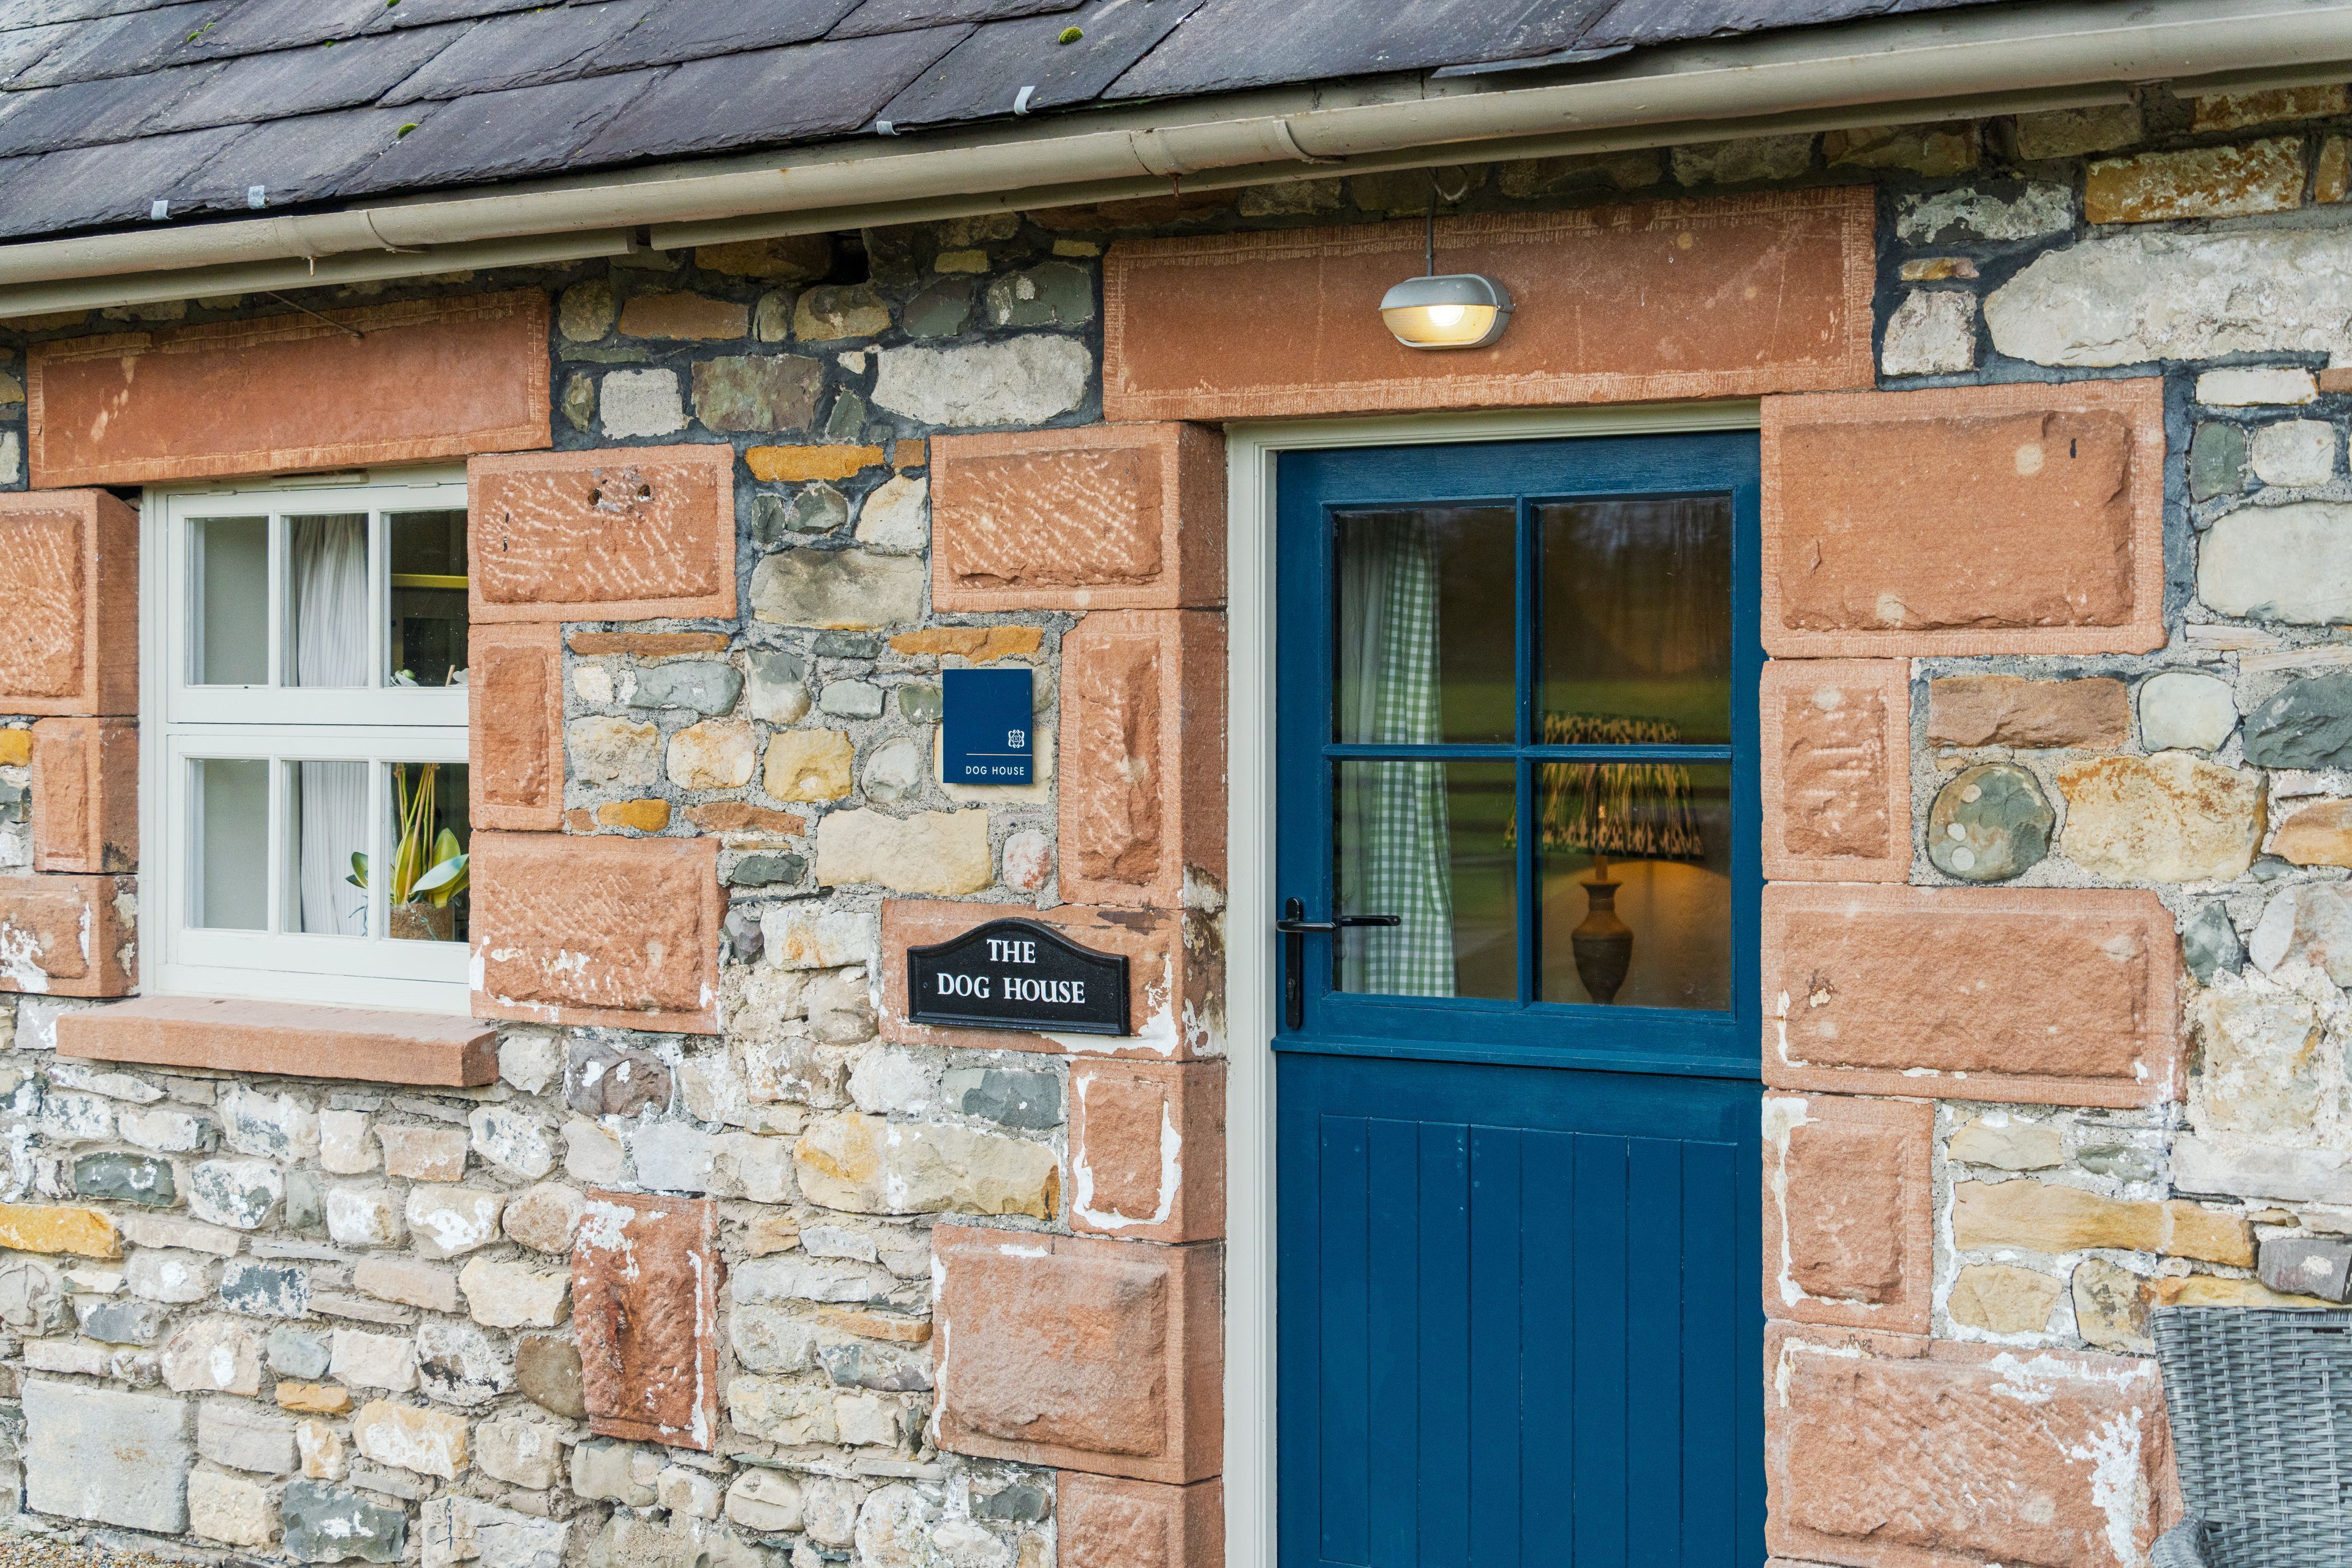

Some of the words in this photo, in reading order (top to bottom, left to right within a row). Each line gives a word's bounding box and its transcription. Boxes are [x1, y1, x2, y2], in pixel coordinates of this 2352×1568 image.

[966, 766, 987, 775] DOG
[992, 766, 1025, 775] HOUSE
[987, 938, 1036, 963] THE
[937, 973, 990, 999] DOG
[1003, 978, 1085, 1004] HOUSE
